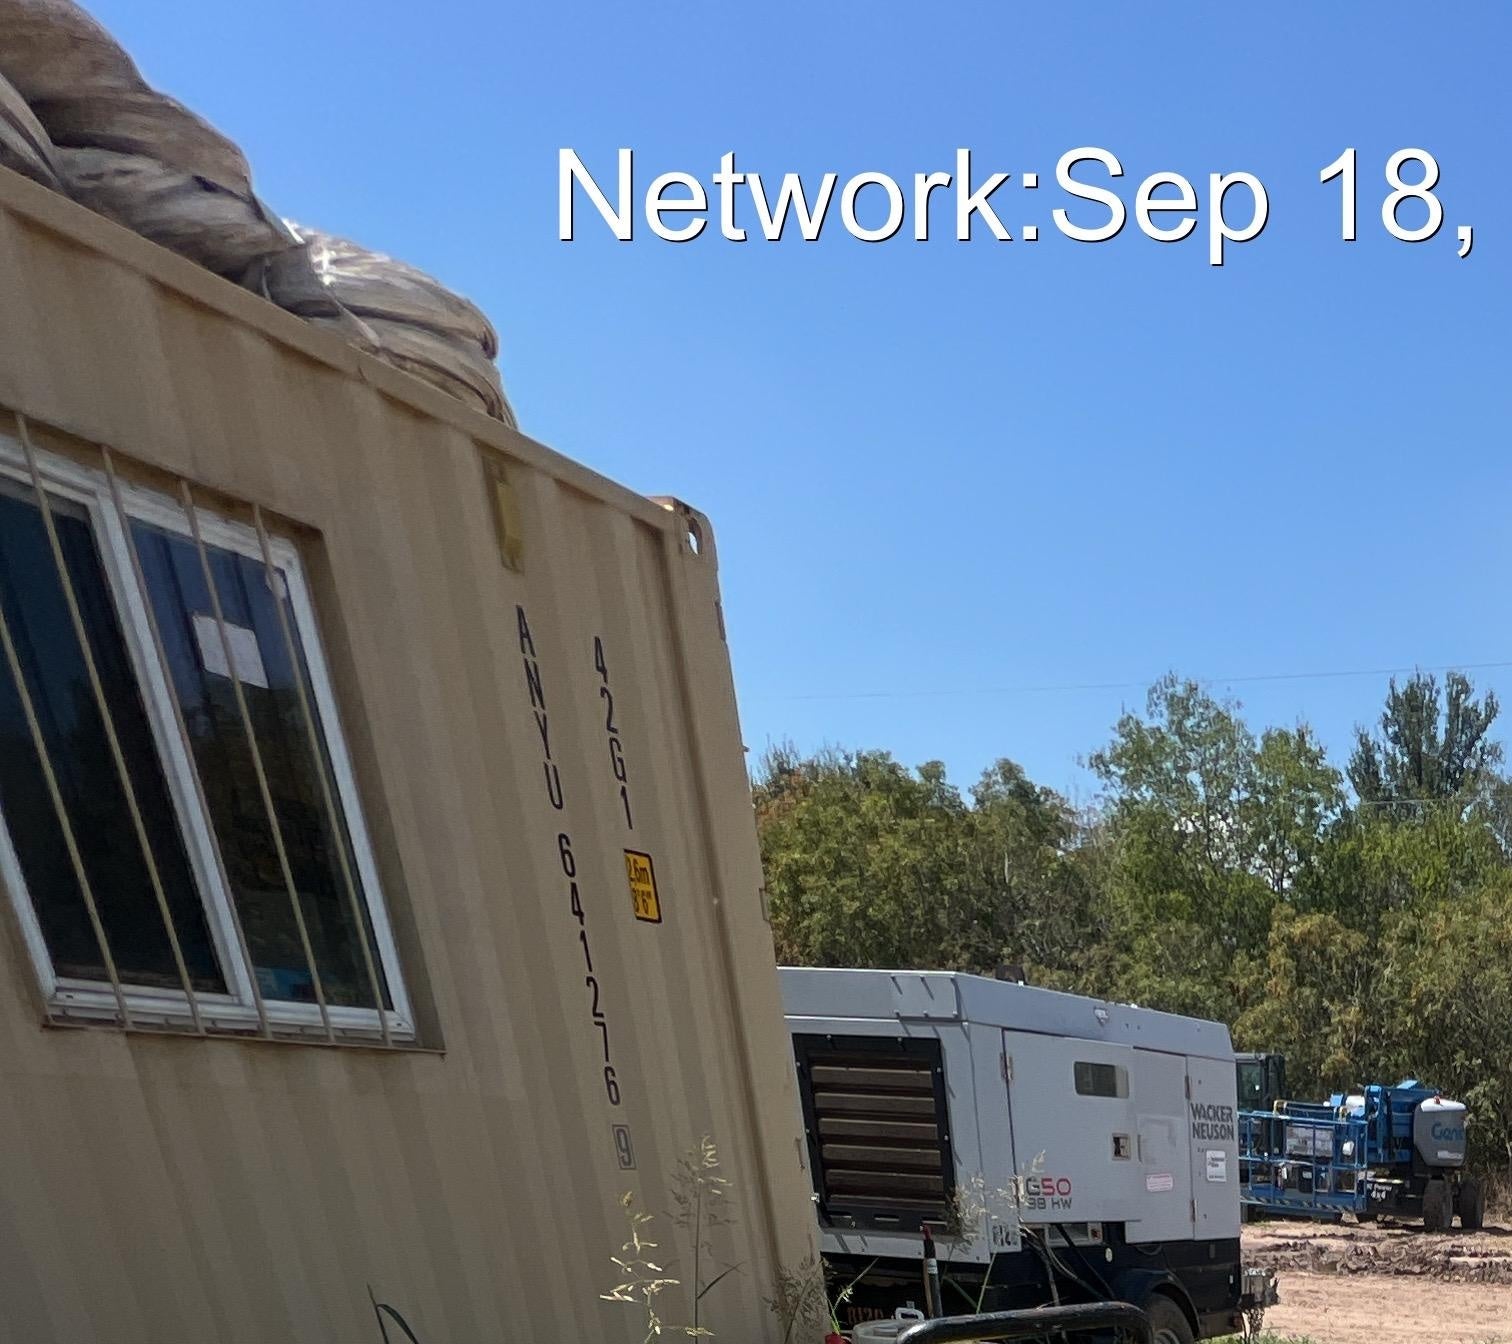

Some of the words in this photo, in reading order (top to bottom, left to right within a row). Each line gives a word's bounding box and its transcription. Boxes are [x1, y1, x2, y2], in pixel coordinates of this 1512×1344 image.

[594, 635, 634, 830] 42G1
[516, 604, 564, 810] ANYU
[558, 832, 621, 1106] 641276
[1190, 1102, 1234, 1123] WACKER
[1192, 1121, 1235, 1142] NEUSON
[1025, 1176, 1072, 1197] G50
